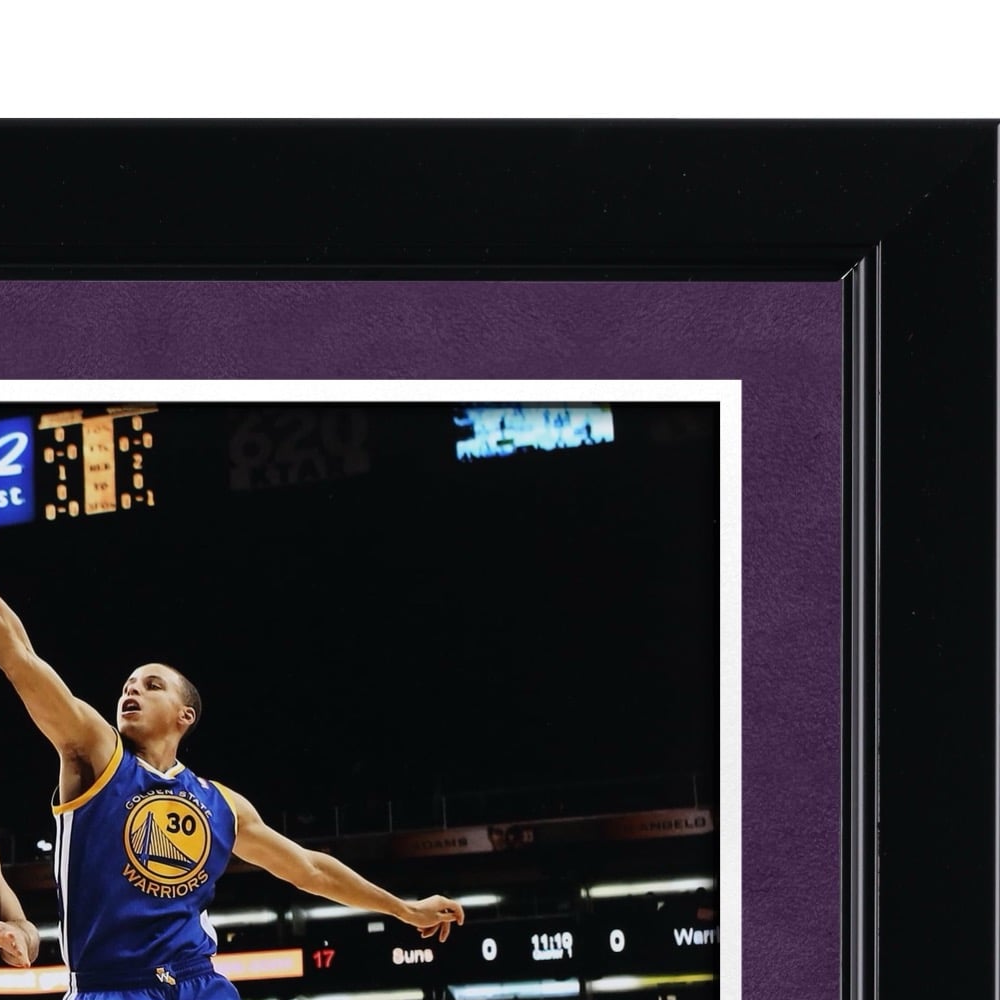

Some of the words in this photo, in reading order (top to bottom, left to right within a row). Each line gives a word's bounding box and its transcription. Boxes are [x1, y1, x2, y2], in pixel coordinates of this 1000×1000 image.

[125, 788, 174, 810] GOLDEN
[179, 790, 213, 819] STATE
[166, 812, 197, 836] 30
[122, 863, 209, 898] WARRIORS
[481, 937, 497, 961] 0
[609, 929, 626, 952] 0
[312, 949, 336, 968] 17
[391, 947, 434, 965] Suns
